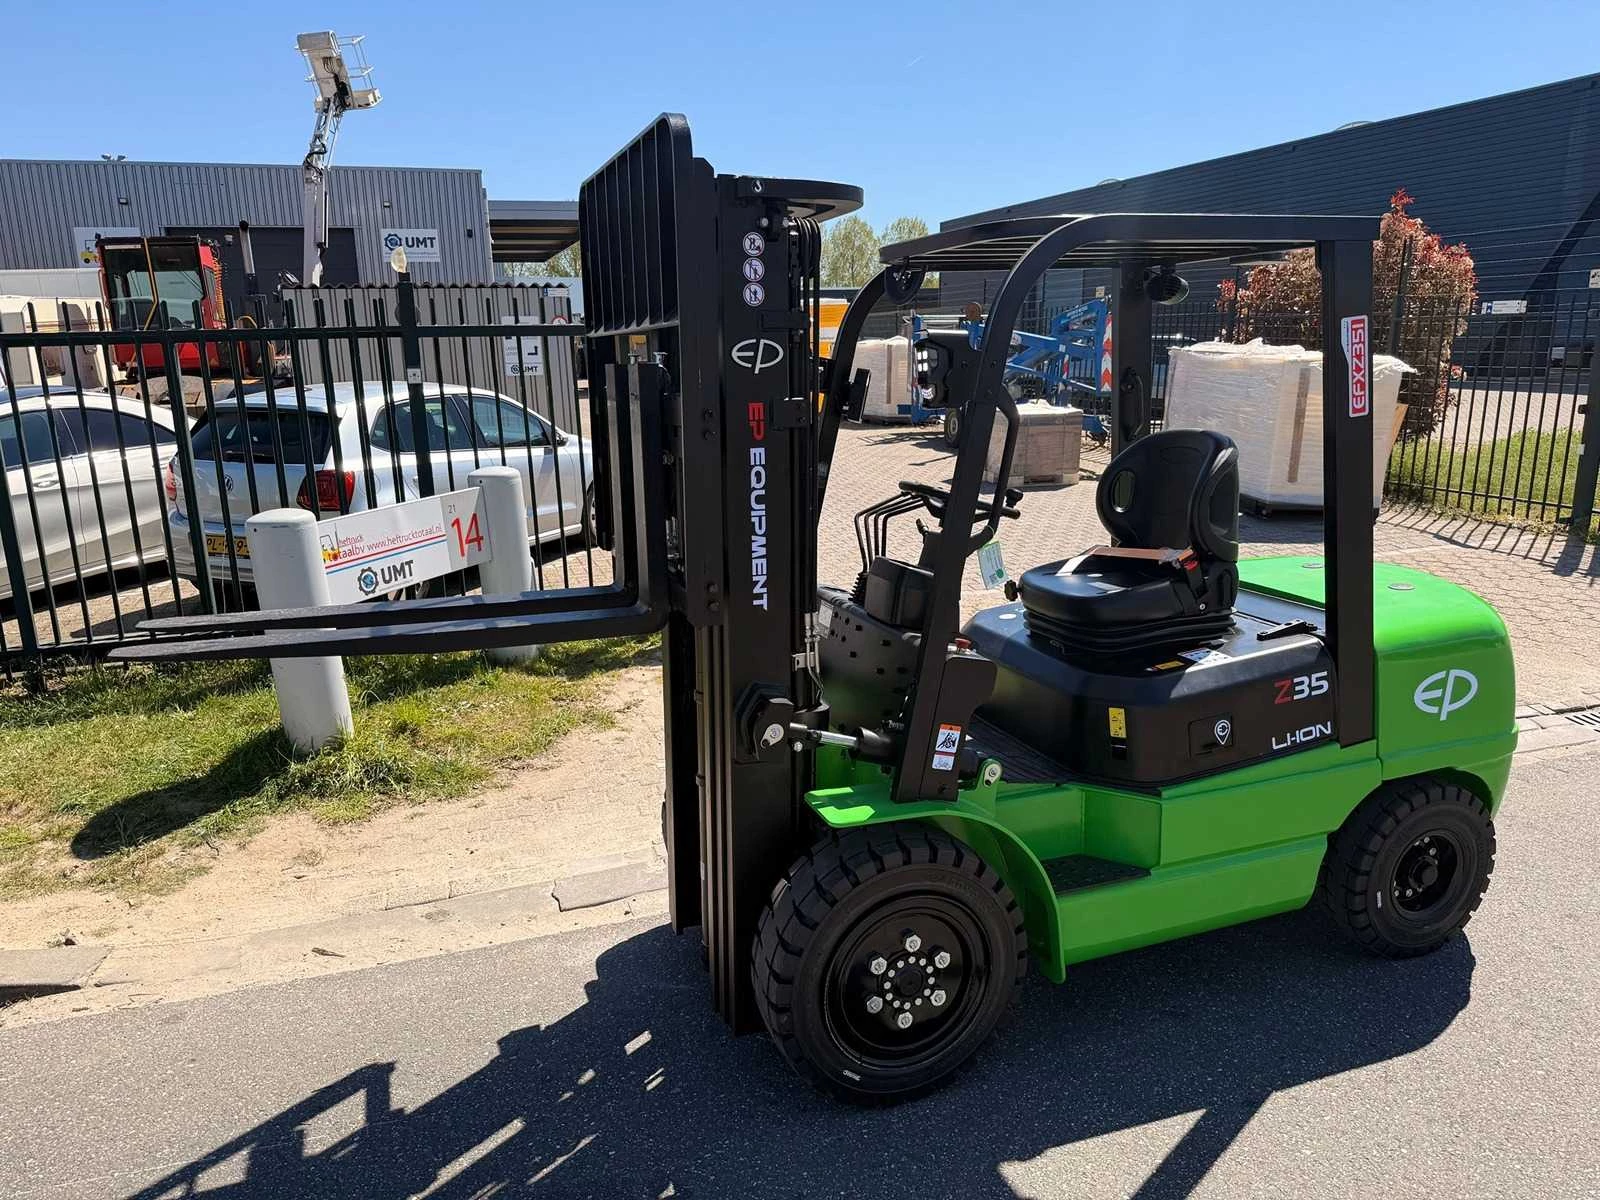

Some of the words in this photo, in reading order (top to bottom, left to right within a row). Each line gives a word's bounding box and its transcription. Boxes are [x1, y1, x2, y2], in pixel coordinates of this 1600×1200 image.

[405, 236, 436, 248] UMT
[731, 338, 785, 374] EP
[747, 402, 765, 441] EP
[448, 504, 456, 514] 21
[451, 513, 484, 557] 14
[749, 447, 768, 610] EQUIPMENT
[381, 560, 414, 584] UMT
[1274, 671, 1329, 704] Z35
[1414, 668, 1478, 721] EP
